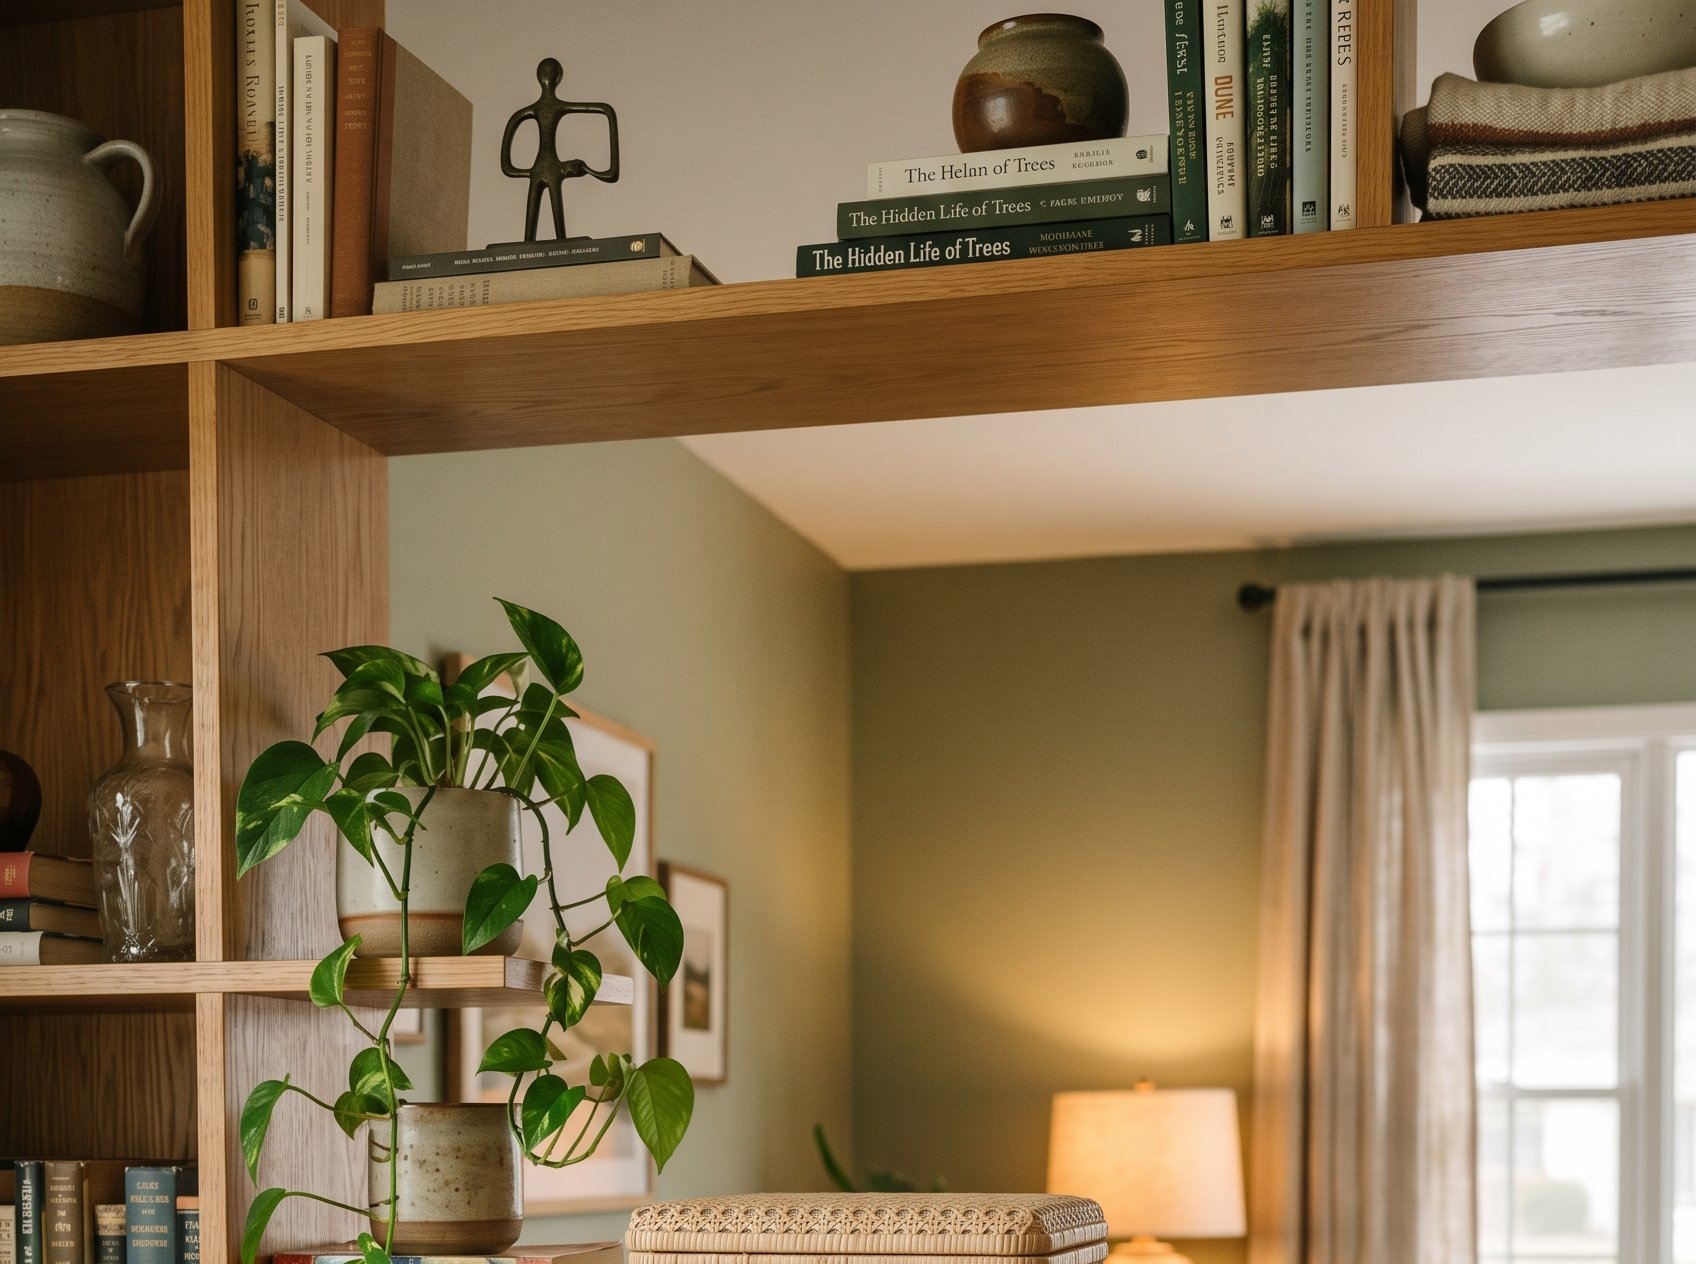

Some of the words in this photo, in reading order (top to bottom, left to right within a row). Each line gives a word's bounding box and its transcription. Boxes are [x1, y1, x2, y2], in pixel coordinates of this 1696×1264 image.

[1214, 74, 1235, 121] DUNE
[904, 167, 936, 184] The
[993, 158, 1011, 175] of
[1013, 157, 1056, 174] Trees
[848, 211, 878, 227] The
[881, 205, 936, 225] Hidden
[939, 204, 969, 220] Life
[972, 200, 988, 217] of
[991, 199, 1032, 215] Trees
[812, 249, 843, 271] The
[847, 244, 905, 269] Hidden
[909, 240, 940, 263] Life
[945, 238, 962, 260] of
[964, 237, 1011, 258] Trees
